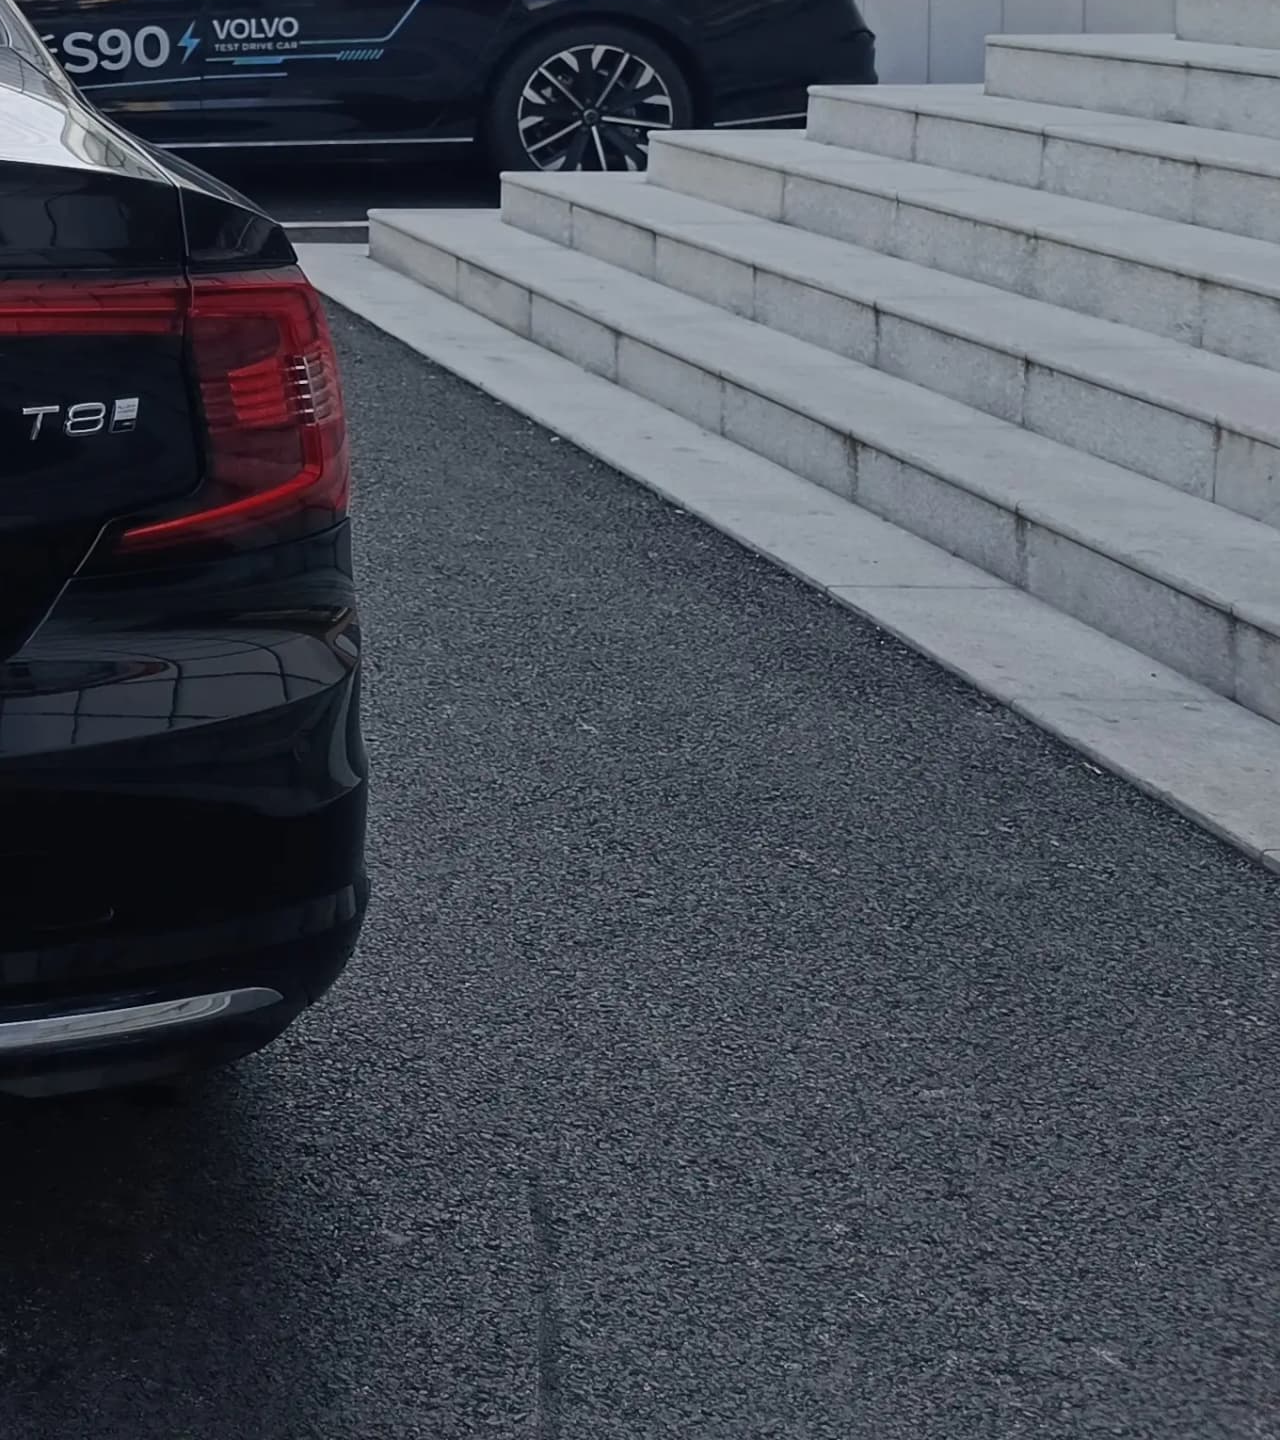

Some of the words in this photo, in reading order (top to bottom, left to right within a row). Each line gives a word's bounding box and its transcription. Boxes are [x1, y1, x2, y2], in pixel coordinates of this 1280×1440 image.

[212, 16, 299, 40] VOLVO
[42, 25, 170, 74] S90
[214, 43, 240, 52] TEST
[241, 41, 273, 51] DRIVE
[275, 41, 298, 50] CAR
[22, 402, 106, 440] T8
